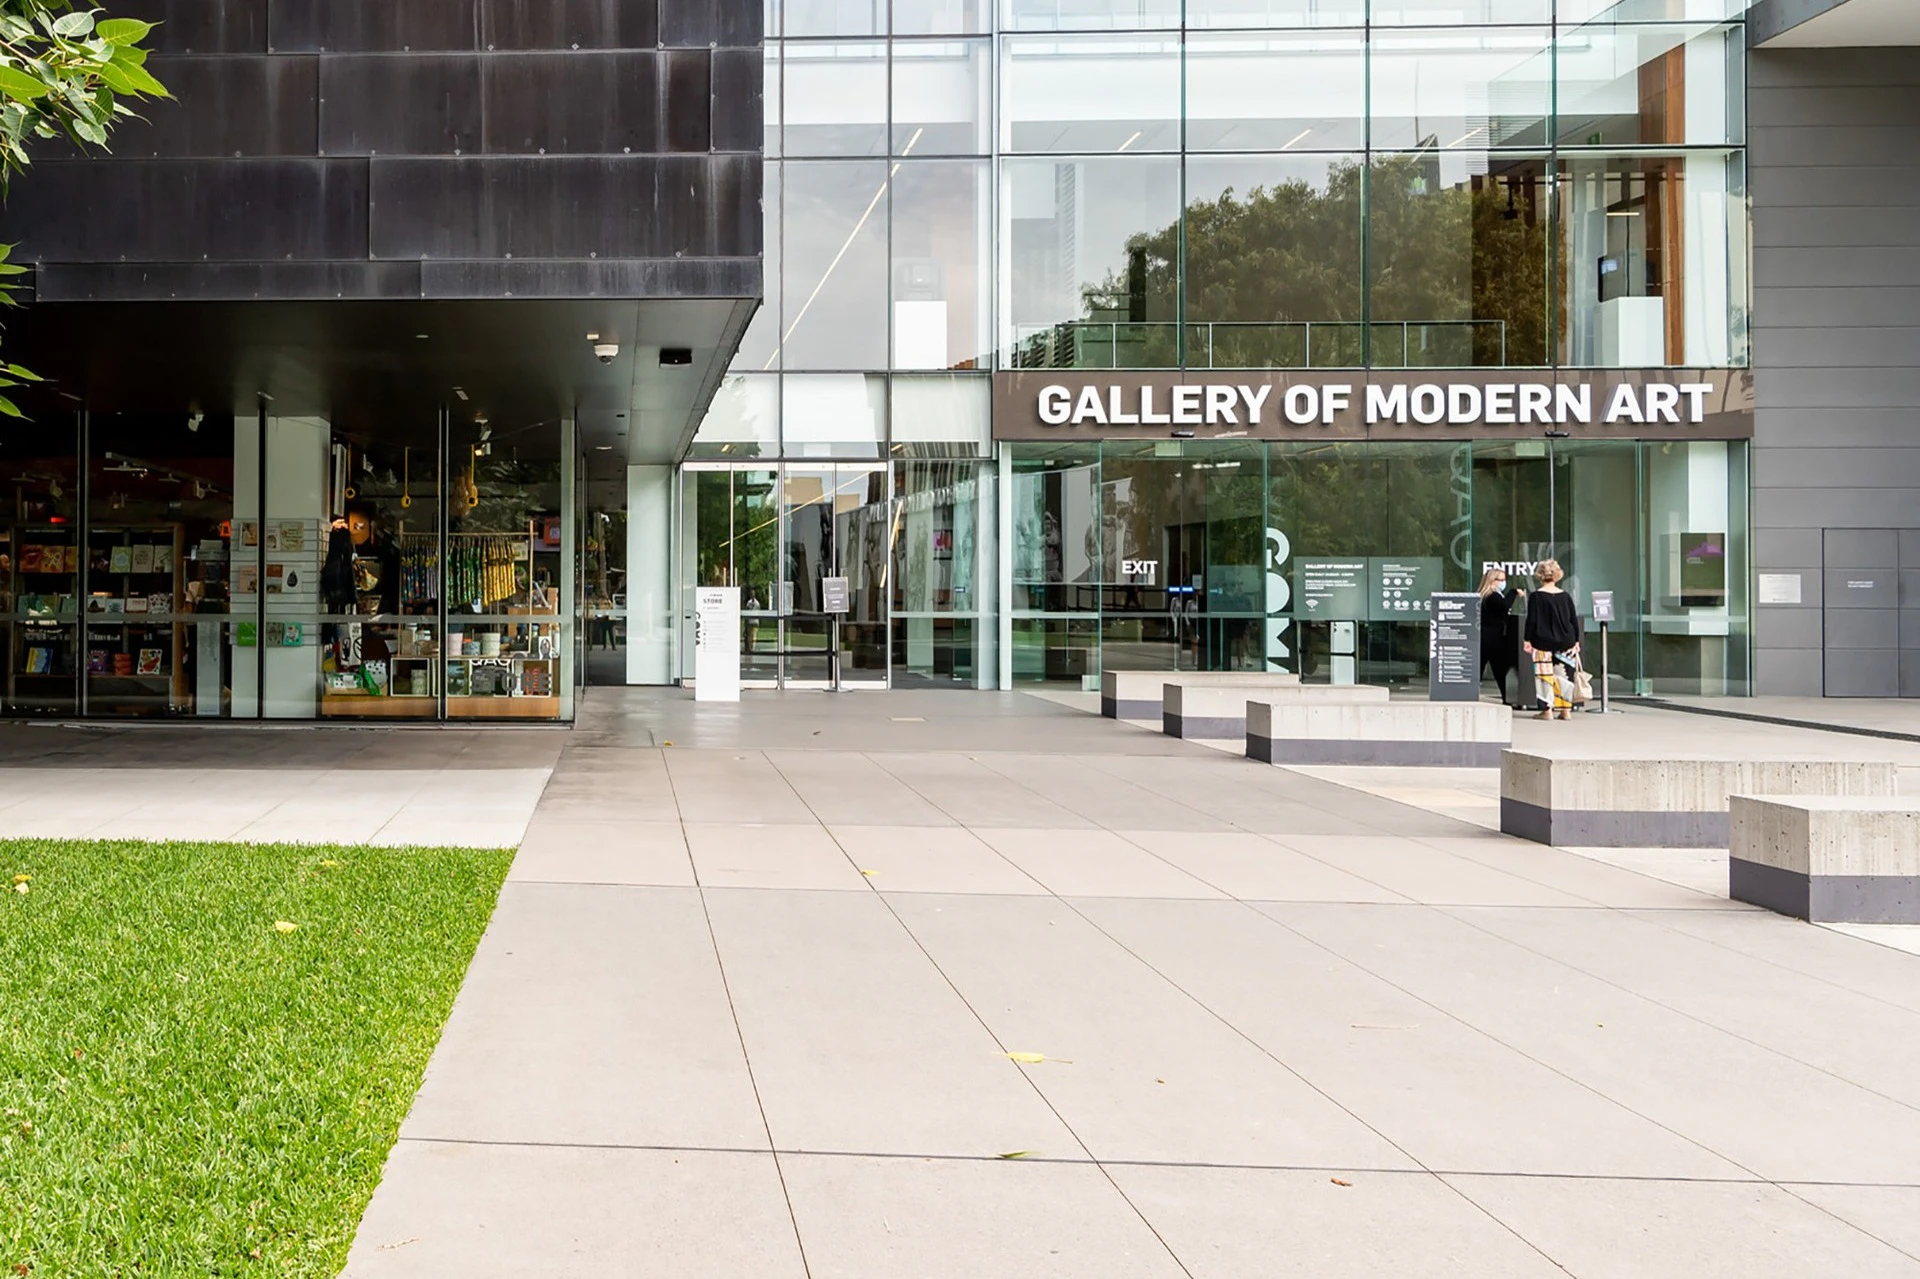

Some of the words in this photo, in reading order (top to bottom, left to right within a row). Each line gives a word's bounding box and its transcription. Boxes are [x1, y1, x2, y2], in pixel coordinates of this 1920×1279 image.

[1037, 384, 1272, 425] GALLERY
[1283, 384, 1352, 425] OF
[1365, 383, 1591, 424] MODERN
[1605, 383, 1714, 423] ART
[1121, 560, 1158, 575] EXIT
[471, 673, 551, 692] STORE
